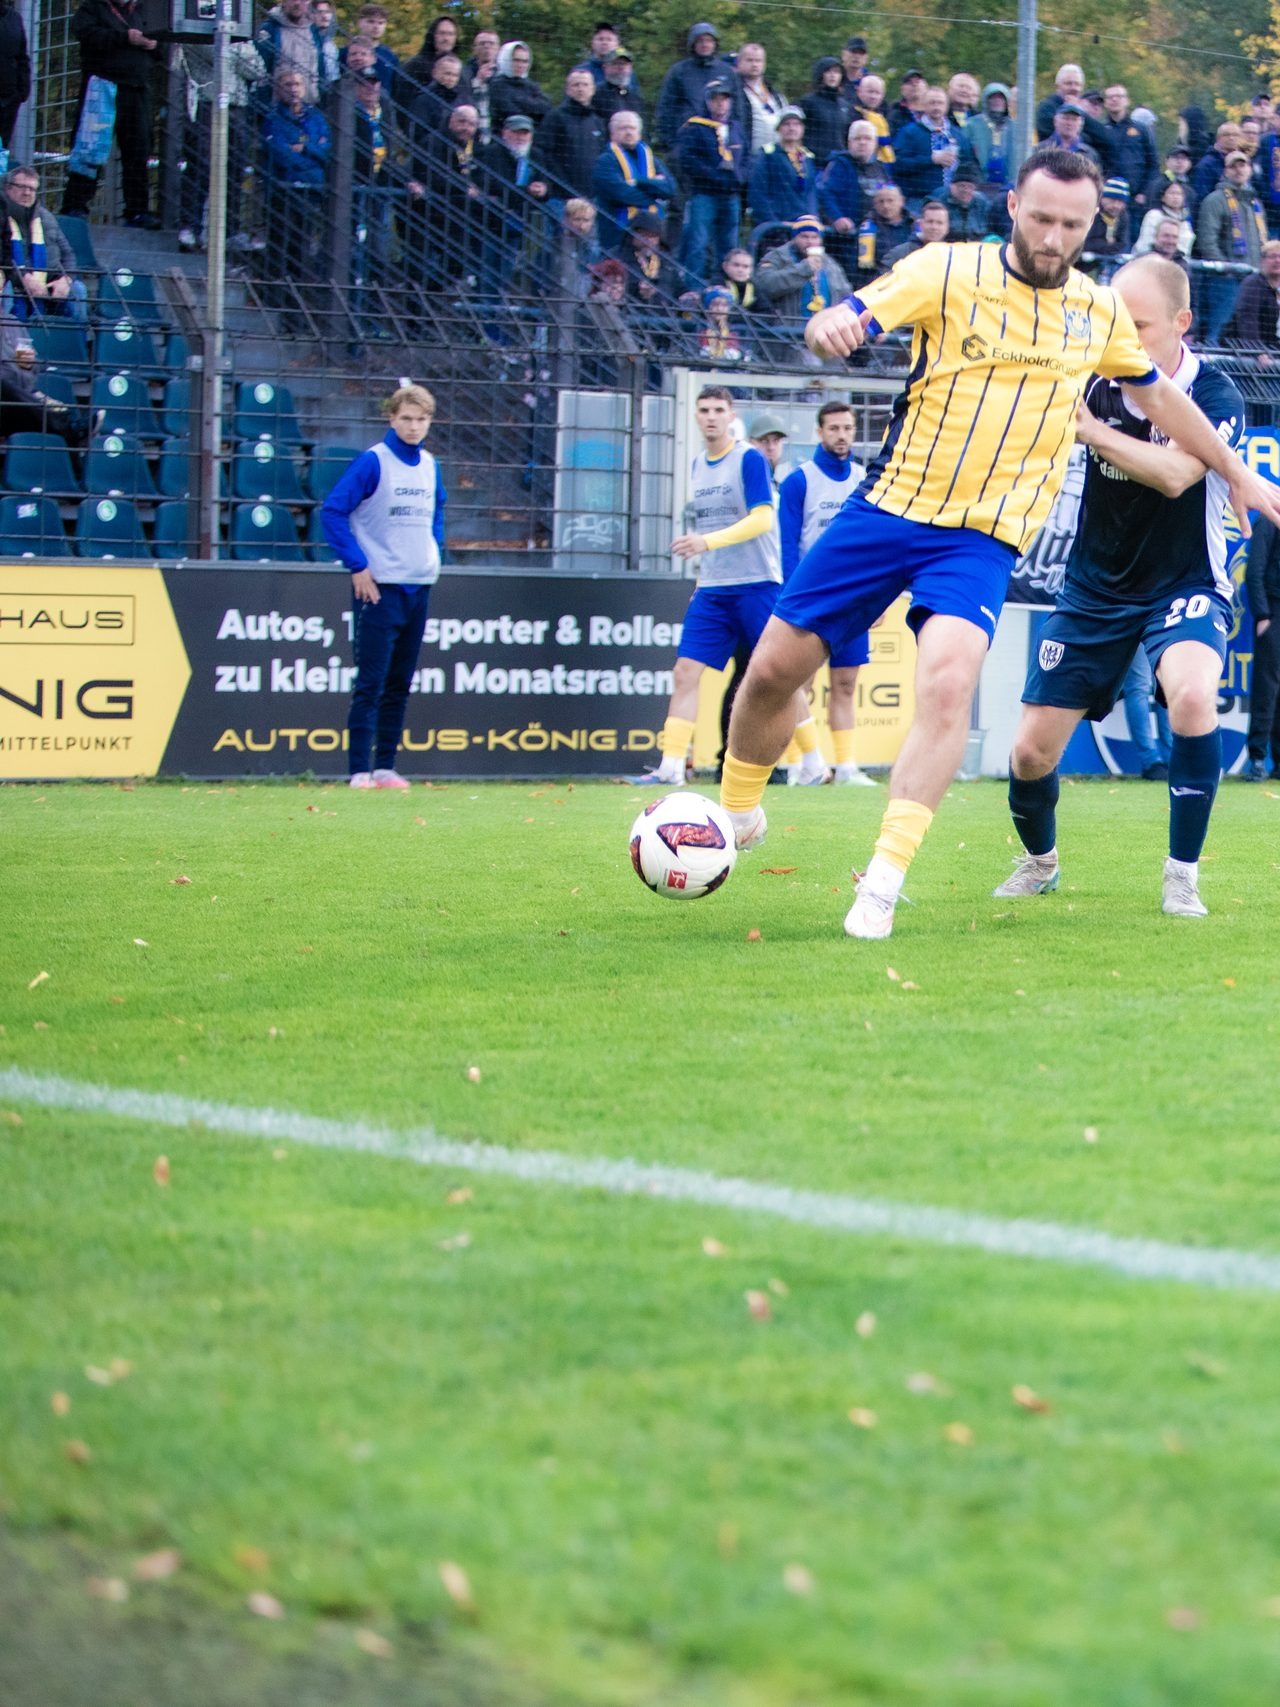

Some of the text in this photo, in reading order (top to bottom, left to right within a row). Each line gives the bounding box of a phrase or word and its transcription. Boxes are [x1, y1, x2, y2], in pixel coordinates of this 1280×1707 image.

[695, 486, 722, 498] CRAFT
[819, 501, 843, 511] CRA
[1164, 594, 1211, 628] 20
[216, 608, 683, 651] Autos, Tsporter & Roller
[215, 656, 674, 696] zu kleinen Monatsraten
[212, 721, 665, 752] AUTOUS-KÖNIG.D
